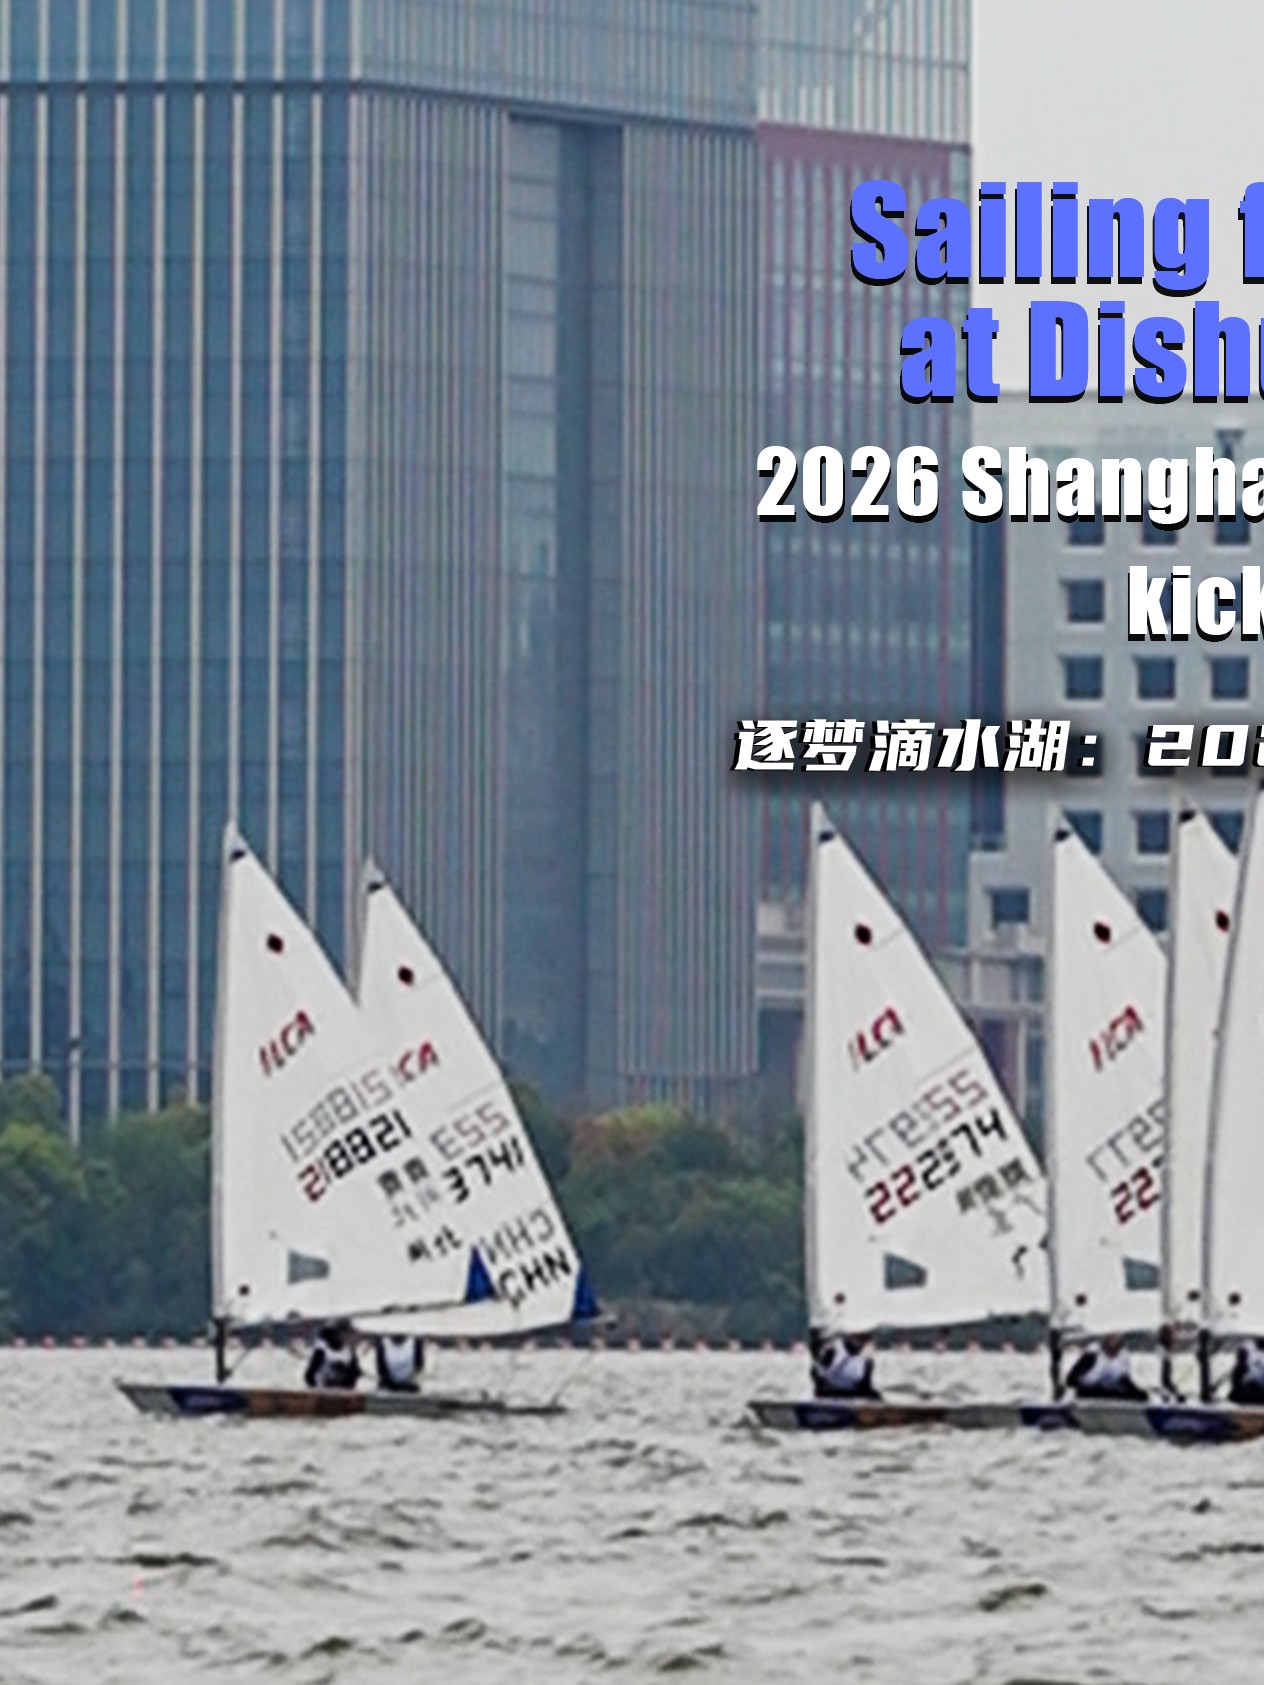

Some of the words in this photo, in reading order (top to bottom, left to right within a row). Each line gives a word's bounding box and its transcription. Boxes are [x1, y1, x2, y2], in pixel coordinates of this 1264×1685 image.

[259, 1010, 315, 1077] ILCA
[392, 1041, 439, 1085] CA
[298, 1108, 412, 1202] 218821
[498, 1246, 571, 1308] CHN
